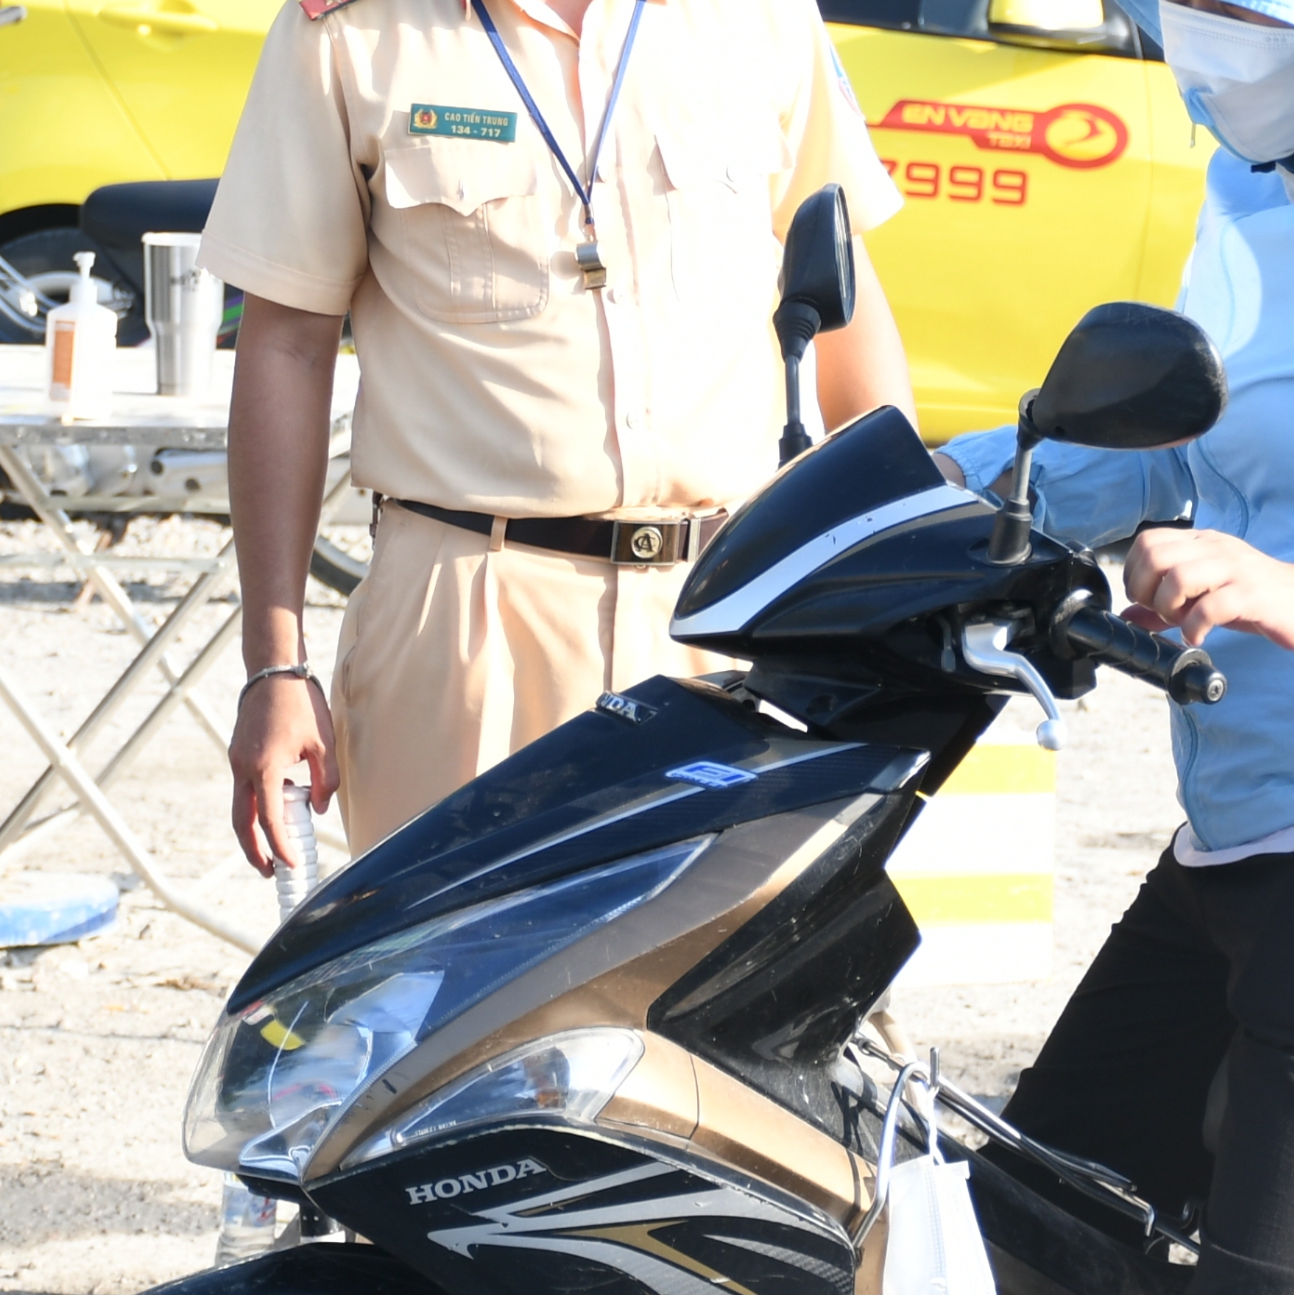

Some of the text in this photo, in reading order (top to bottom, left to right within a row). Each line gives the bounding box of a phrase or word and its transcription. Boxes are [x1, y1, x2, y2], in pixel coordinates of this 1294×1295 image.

[444, 111, 461, 122] CAO
[482, 115, 509, 127] TRUNG
[451, 124, 471, 135] 134
[480, 127, 501, 138] 717
[405, 1158, 547, 1205] HONDA
